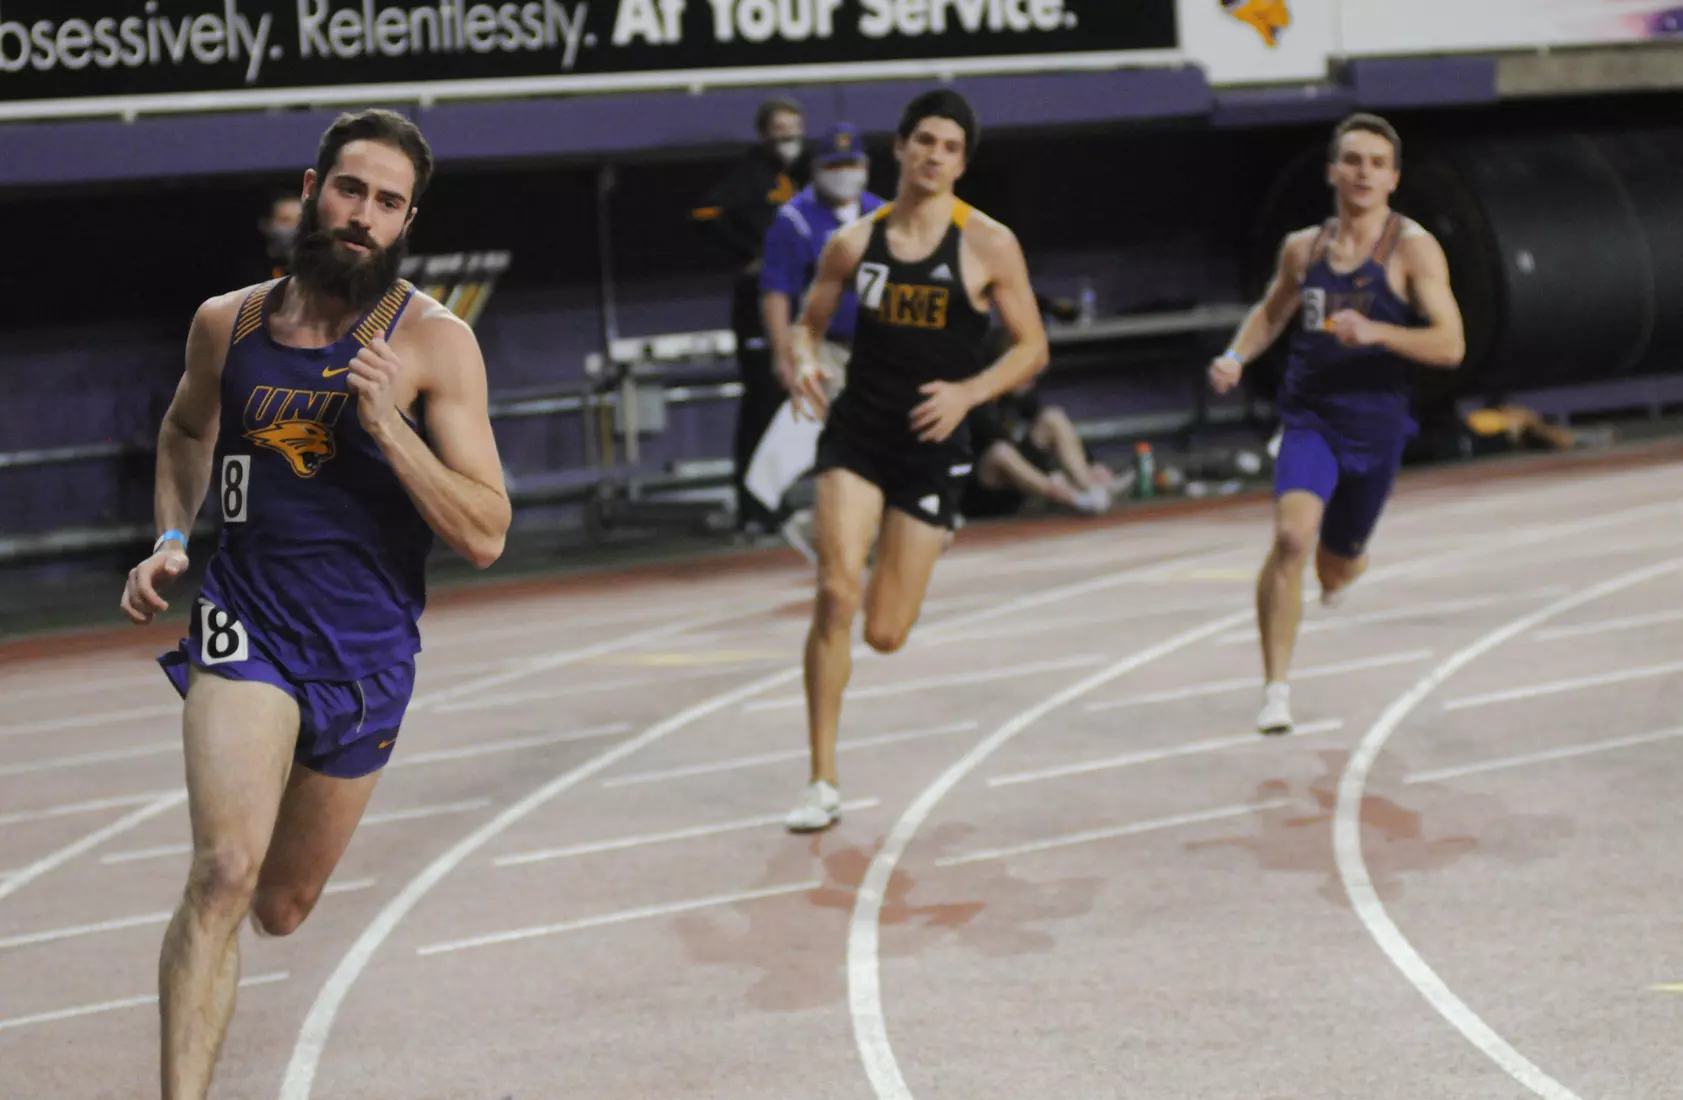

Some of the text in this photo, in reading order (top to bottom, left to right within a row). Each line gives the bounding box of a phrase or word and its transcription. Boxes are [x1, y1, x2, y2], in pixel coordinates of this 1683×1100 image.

[297, 0, 597, 70] Relentlessly.
[857, 0, 1078, 38] Service.
[863, 267, 881, 304] 7
[243, 385, 349, 430] UNI
[223, 459, 244, 519] 8
[207, 606, 239, 659] 8
